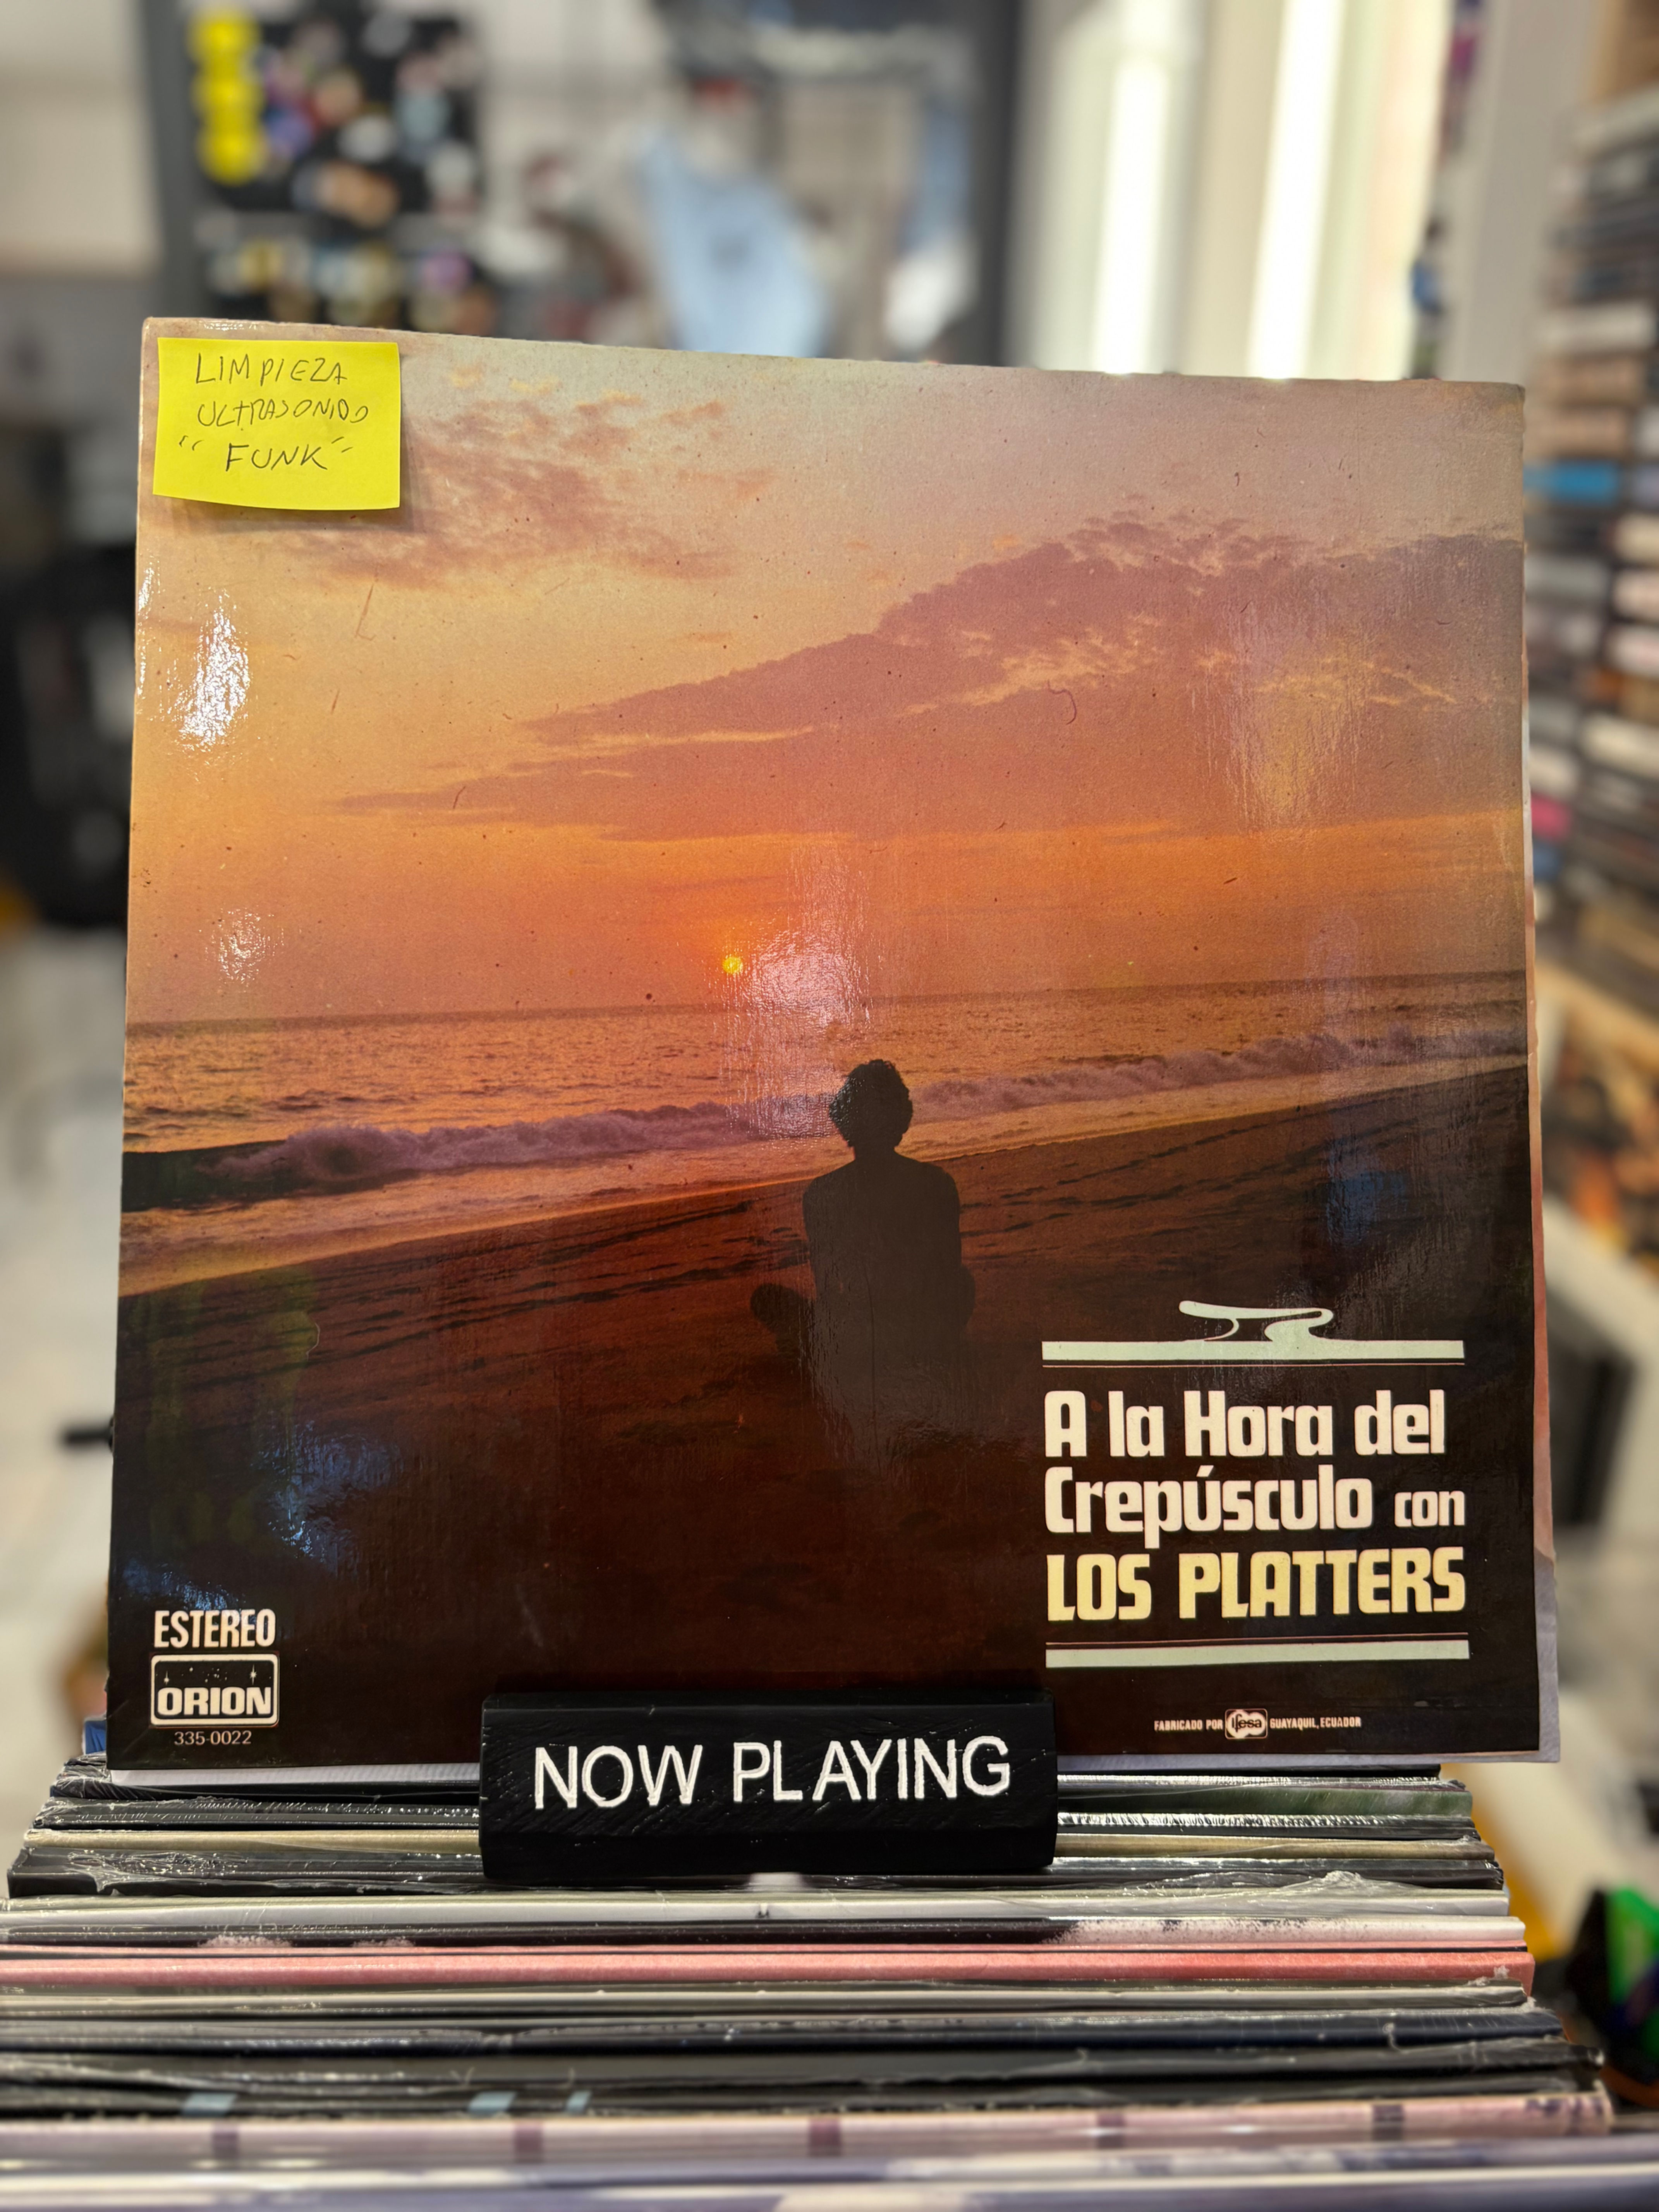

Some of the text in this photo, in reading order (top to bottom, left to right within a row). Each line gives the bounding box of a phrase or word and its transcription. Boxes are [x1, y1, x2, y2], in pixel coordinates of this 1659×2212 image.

[196, 353, 347, 386] LIMPIEZA
[198, 398, 368, 427] ULTRASONIDO
[1044, 1389, 1444, 1457] A la Hora del
[1045, 1464, 1465, 1549] Crepúsculo con
[1047, 1547, 1465, 1621] LOS PLATTERS
[154, 1609, 276, 1648] ESTEREO
[158, 1687, 271, 1716] ORION
[174, 1730, 251, 1745] 335-0022
[1154, 1719, 1202, 1731] FABRICADO
[1206, 1719, 1223, 1730] POR
[1270, 1717, 1319, 1731] GUAYAQUIL,
[1320, 1717, 1361, 1728] ECUADOR
[535, 1735, 1010, 1809] NOW PLAYING
